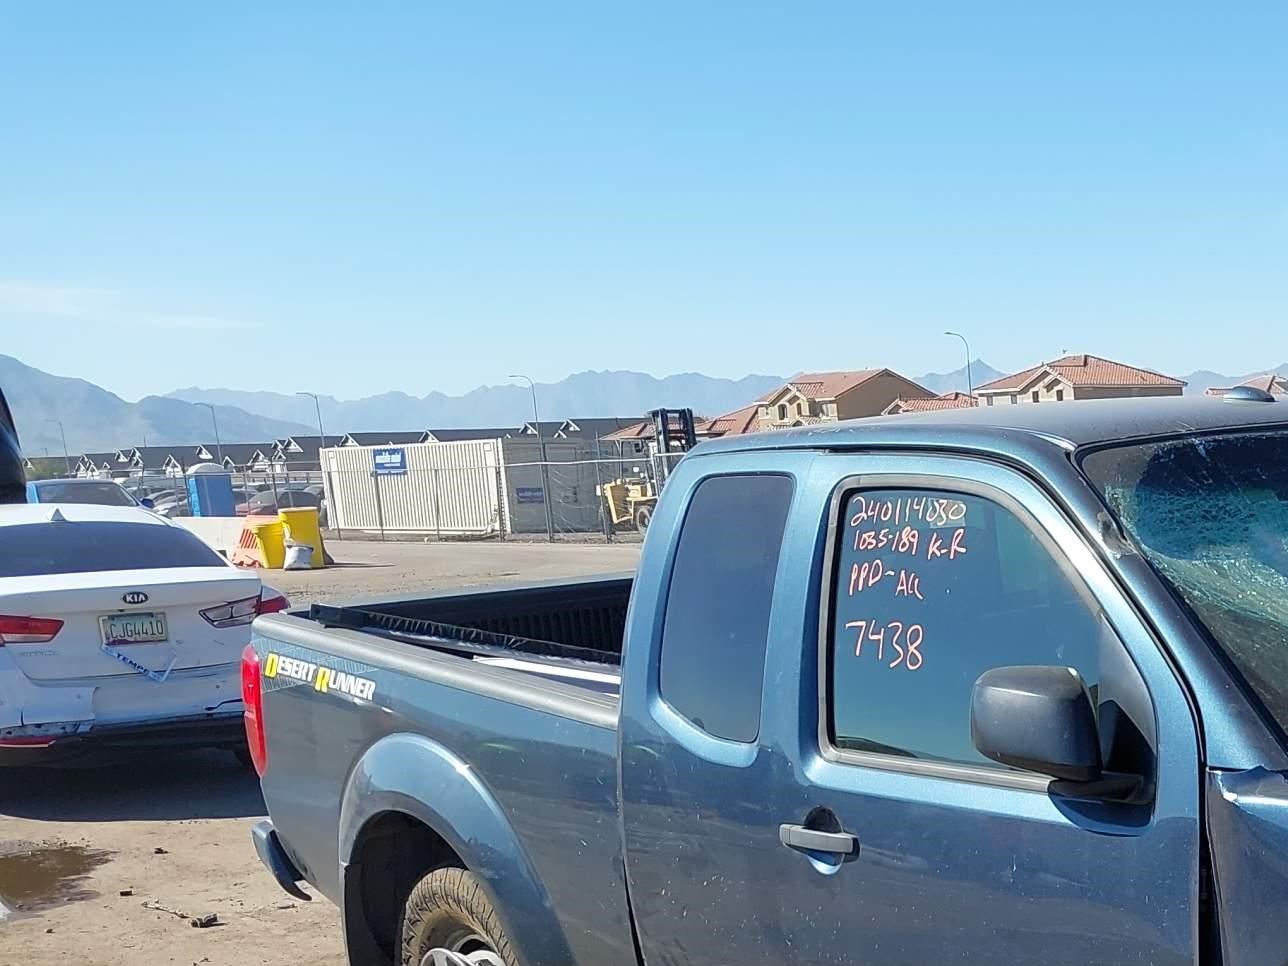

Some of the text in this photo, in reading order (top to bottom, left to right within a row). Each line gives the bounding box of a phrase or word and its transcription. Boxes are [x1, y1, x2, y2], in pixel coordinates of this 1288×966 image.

[124, 593, 146, 603] KIA
[109, 620, 164, 639] CJG4410
[845, 619, 923, 670] 7438
[264, 651, 376, 701] DESERT RUNNER
